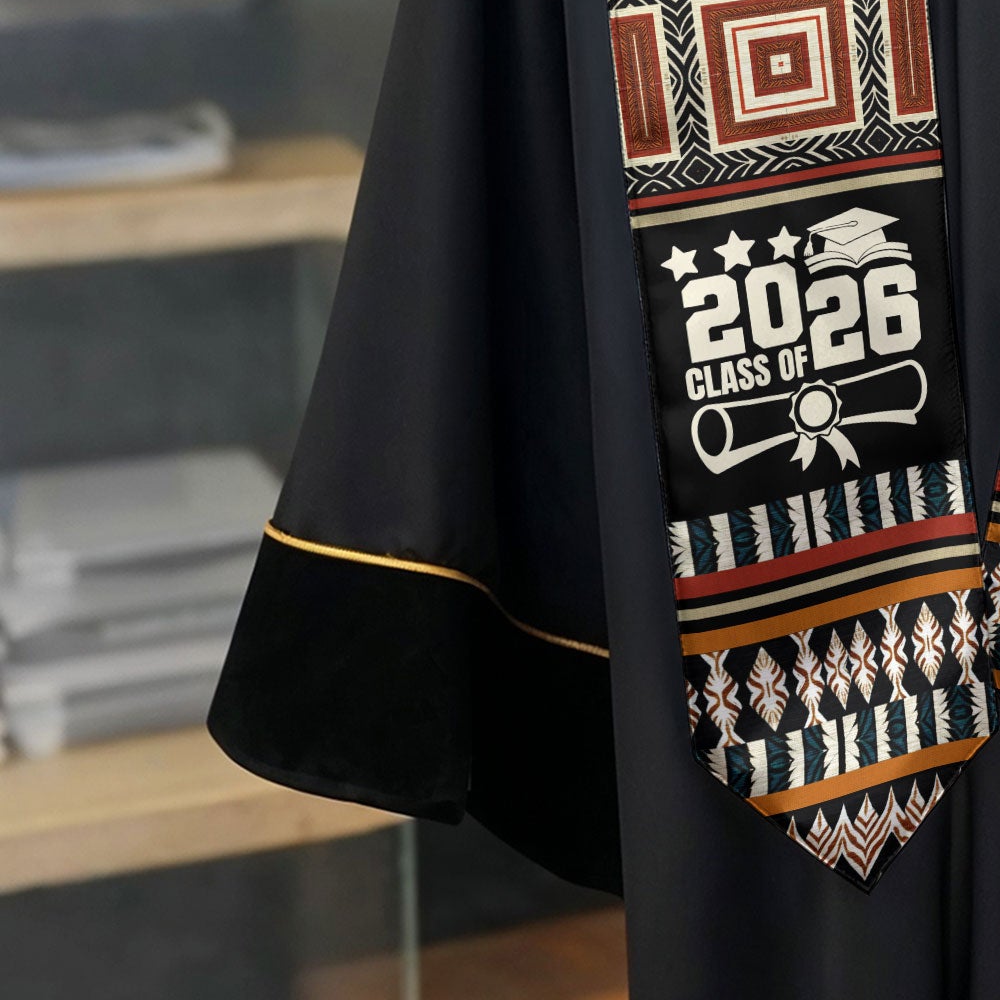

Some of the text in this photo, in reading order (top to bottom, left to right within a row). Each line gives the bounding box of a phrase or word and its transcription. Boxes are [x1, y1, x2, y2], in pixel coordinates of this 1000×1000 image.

[681, 262, 921, 370] 2026
[685, 345, 808, 401] CLASS OF
